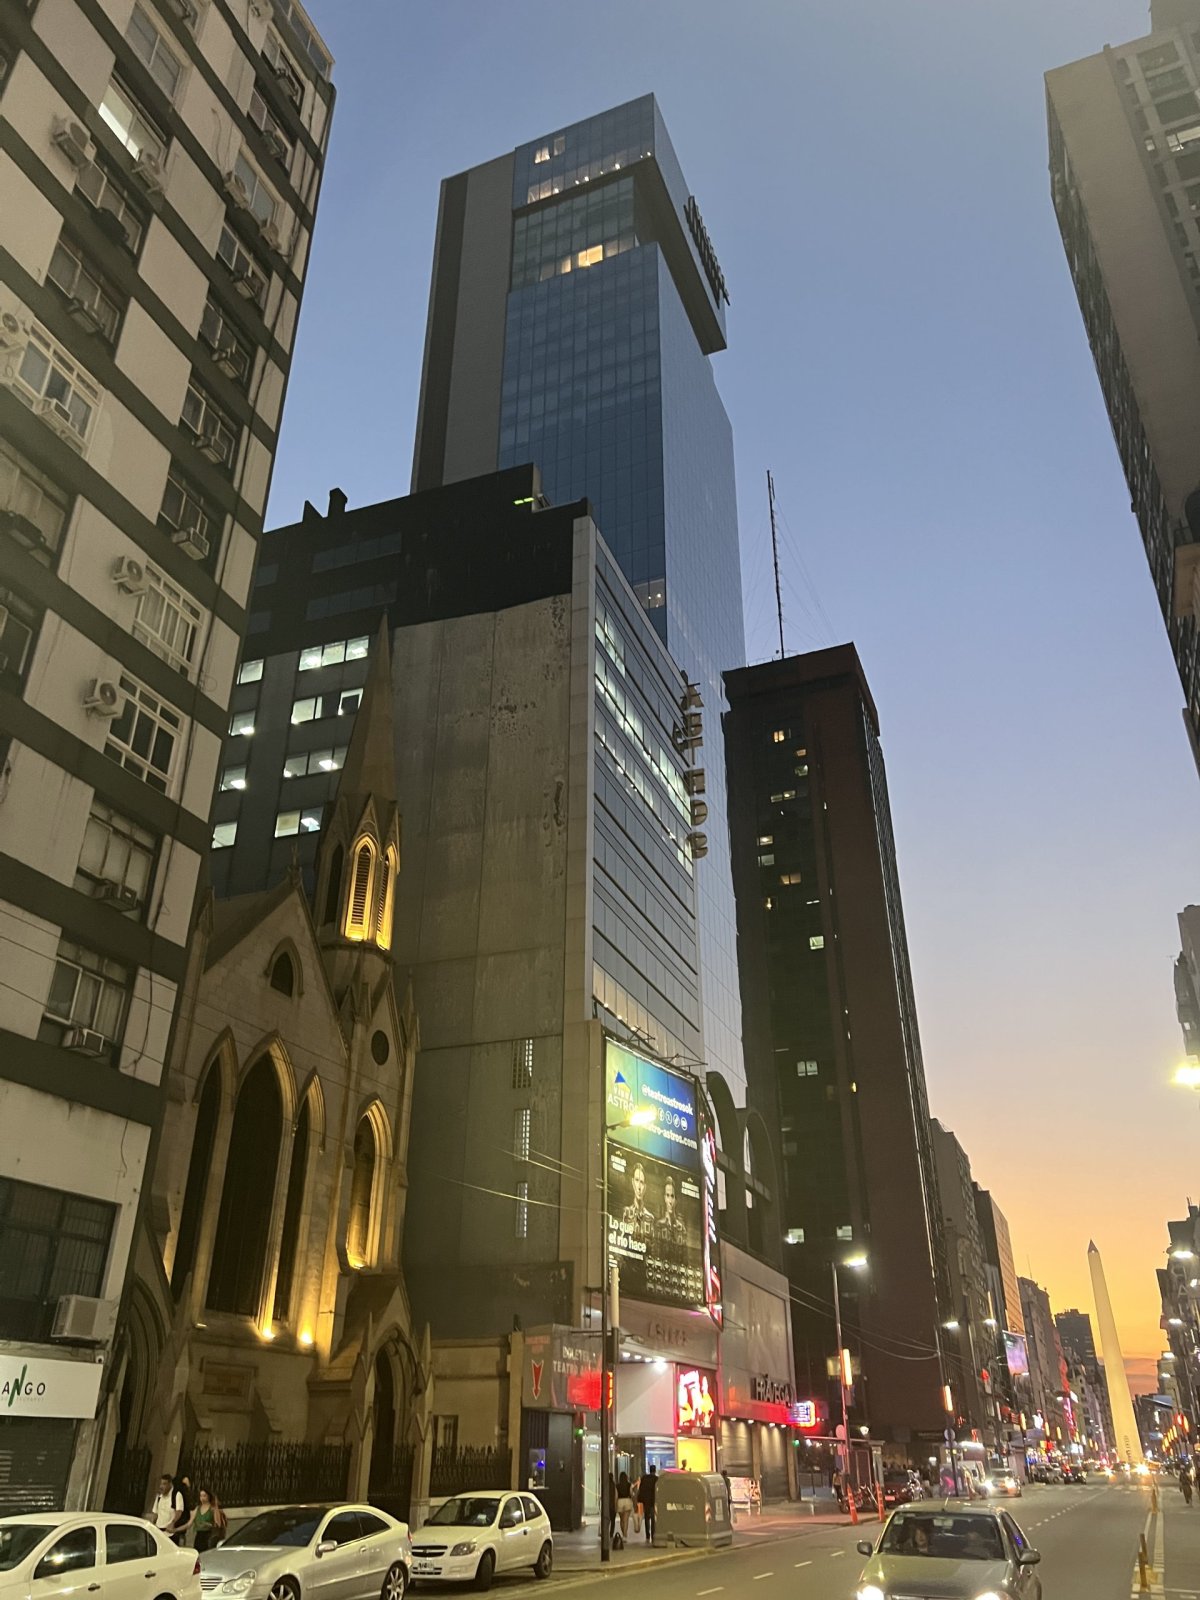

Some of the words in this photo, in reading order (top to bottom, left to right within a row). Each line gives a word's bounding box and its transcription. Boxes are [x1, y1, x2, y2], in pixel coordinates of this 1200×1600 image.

[609, 1215, 619, 1230] Lo
[619, 1221, 634, 1237] que
[608, 1231, 616, 1245] el
[629, 1235, 647, 1253] hace
